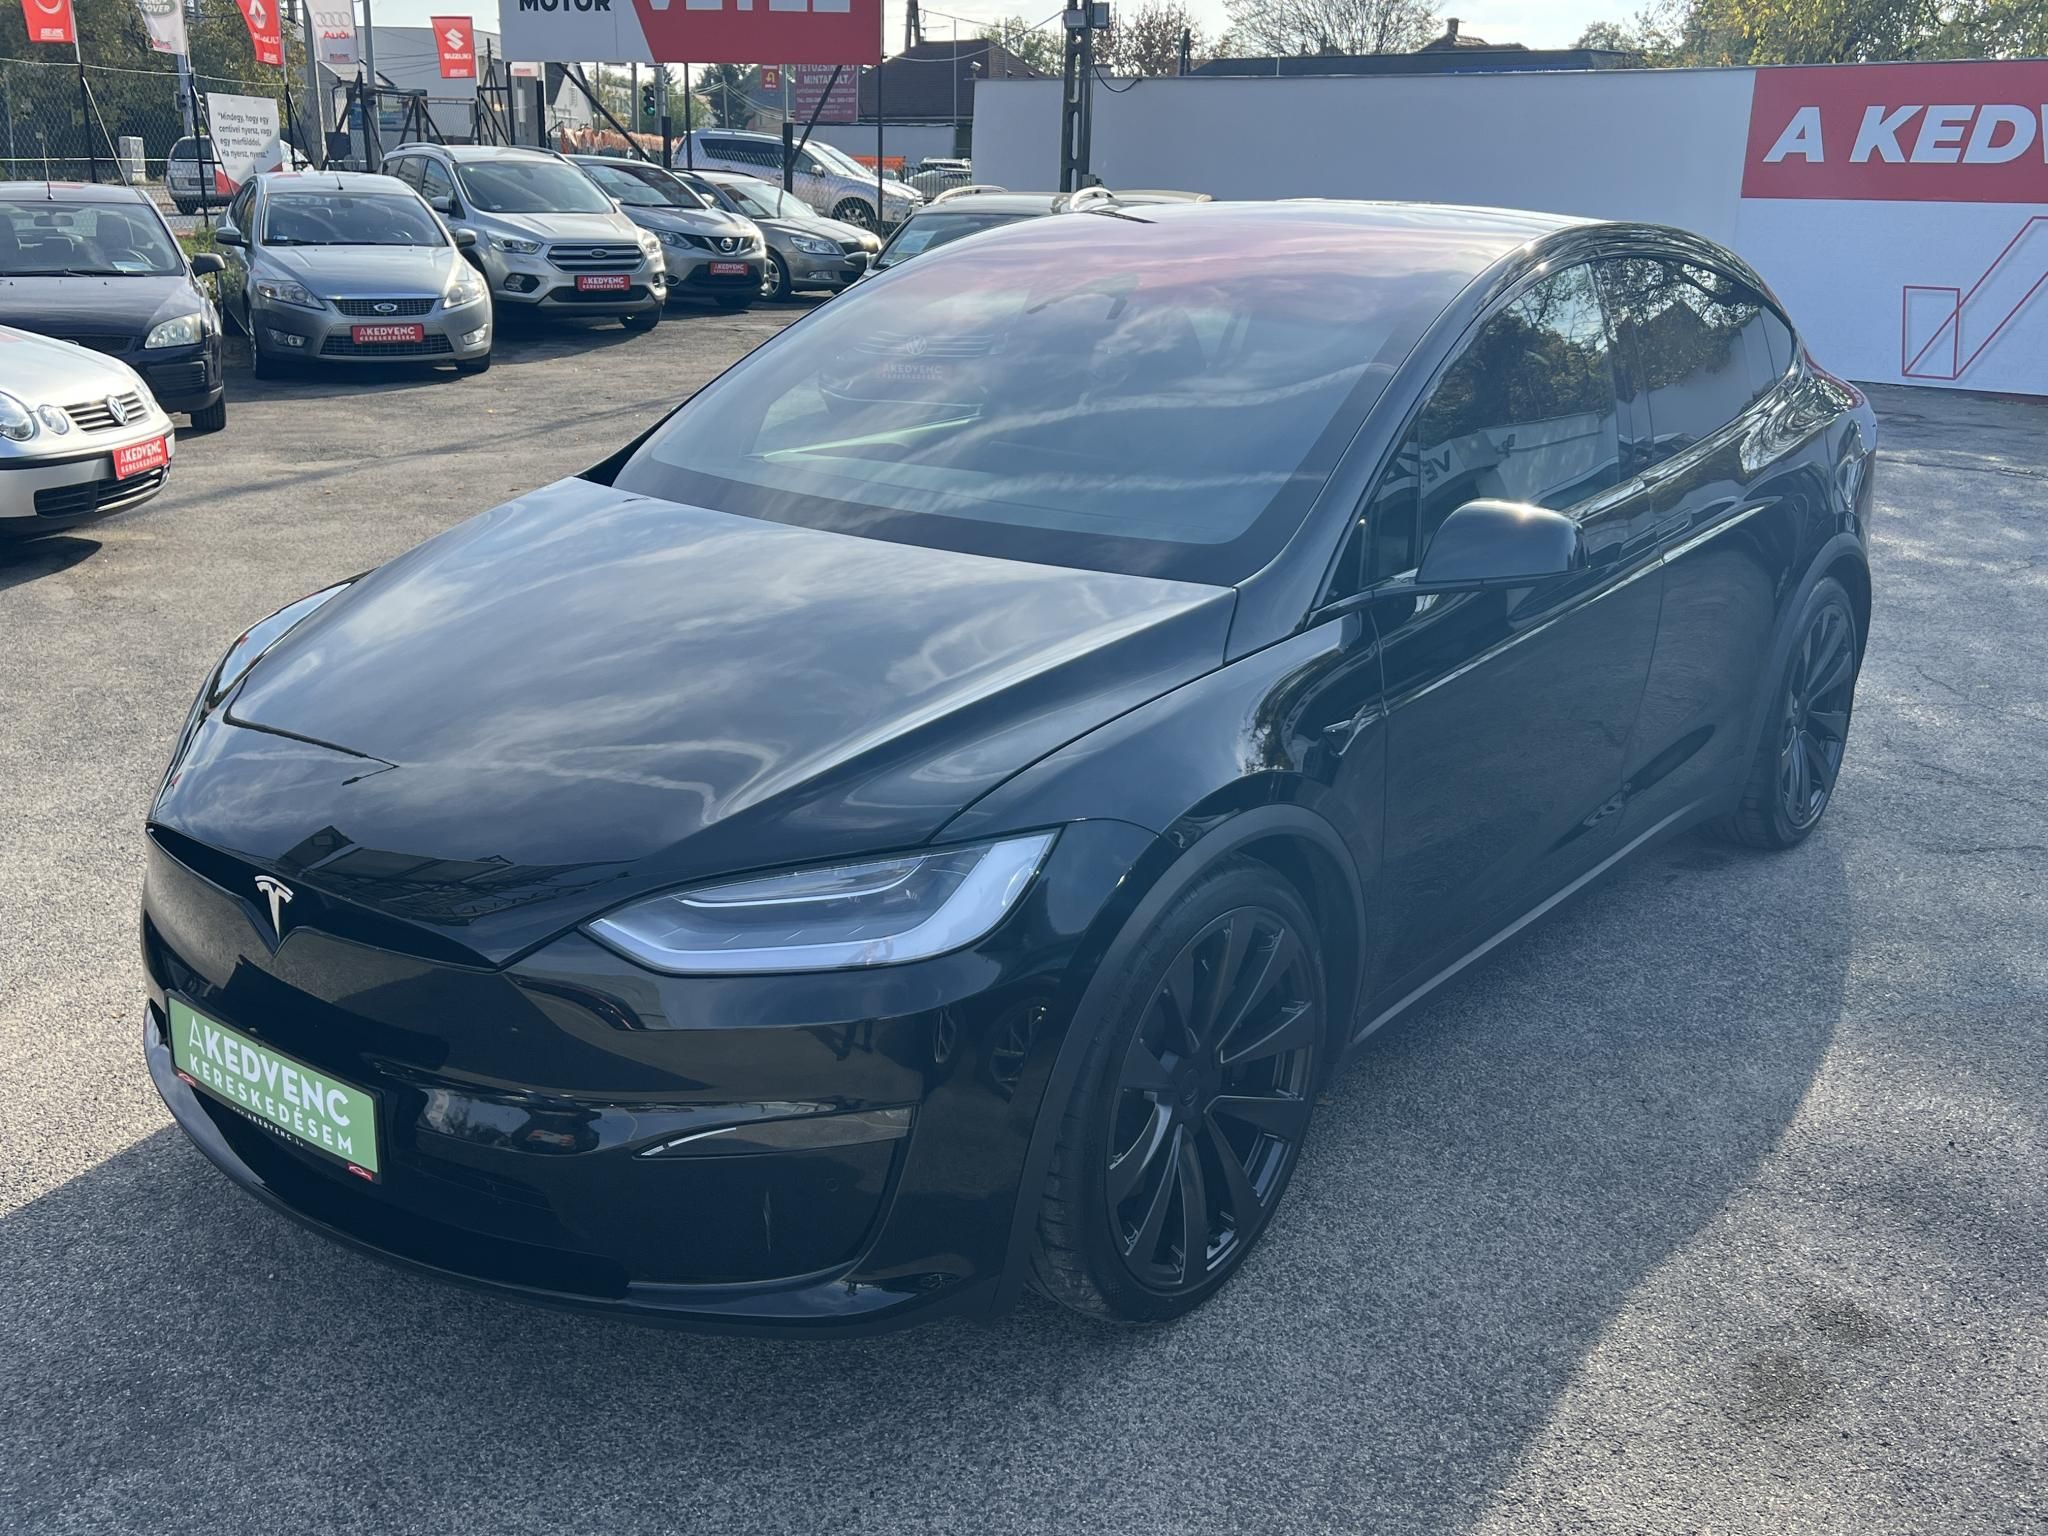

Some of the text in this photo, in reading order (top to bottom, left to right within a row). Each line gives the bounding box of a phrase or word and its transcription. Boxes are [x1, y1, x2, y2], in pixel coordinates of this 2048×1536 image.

[1762, 104, 2048, 165] A KED
[188, 1015, 351, 1127] AKEDVENC
[189, 1053, 353, 1155] KERESKEDÉSEM
